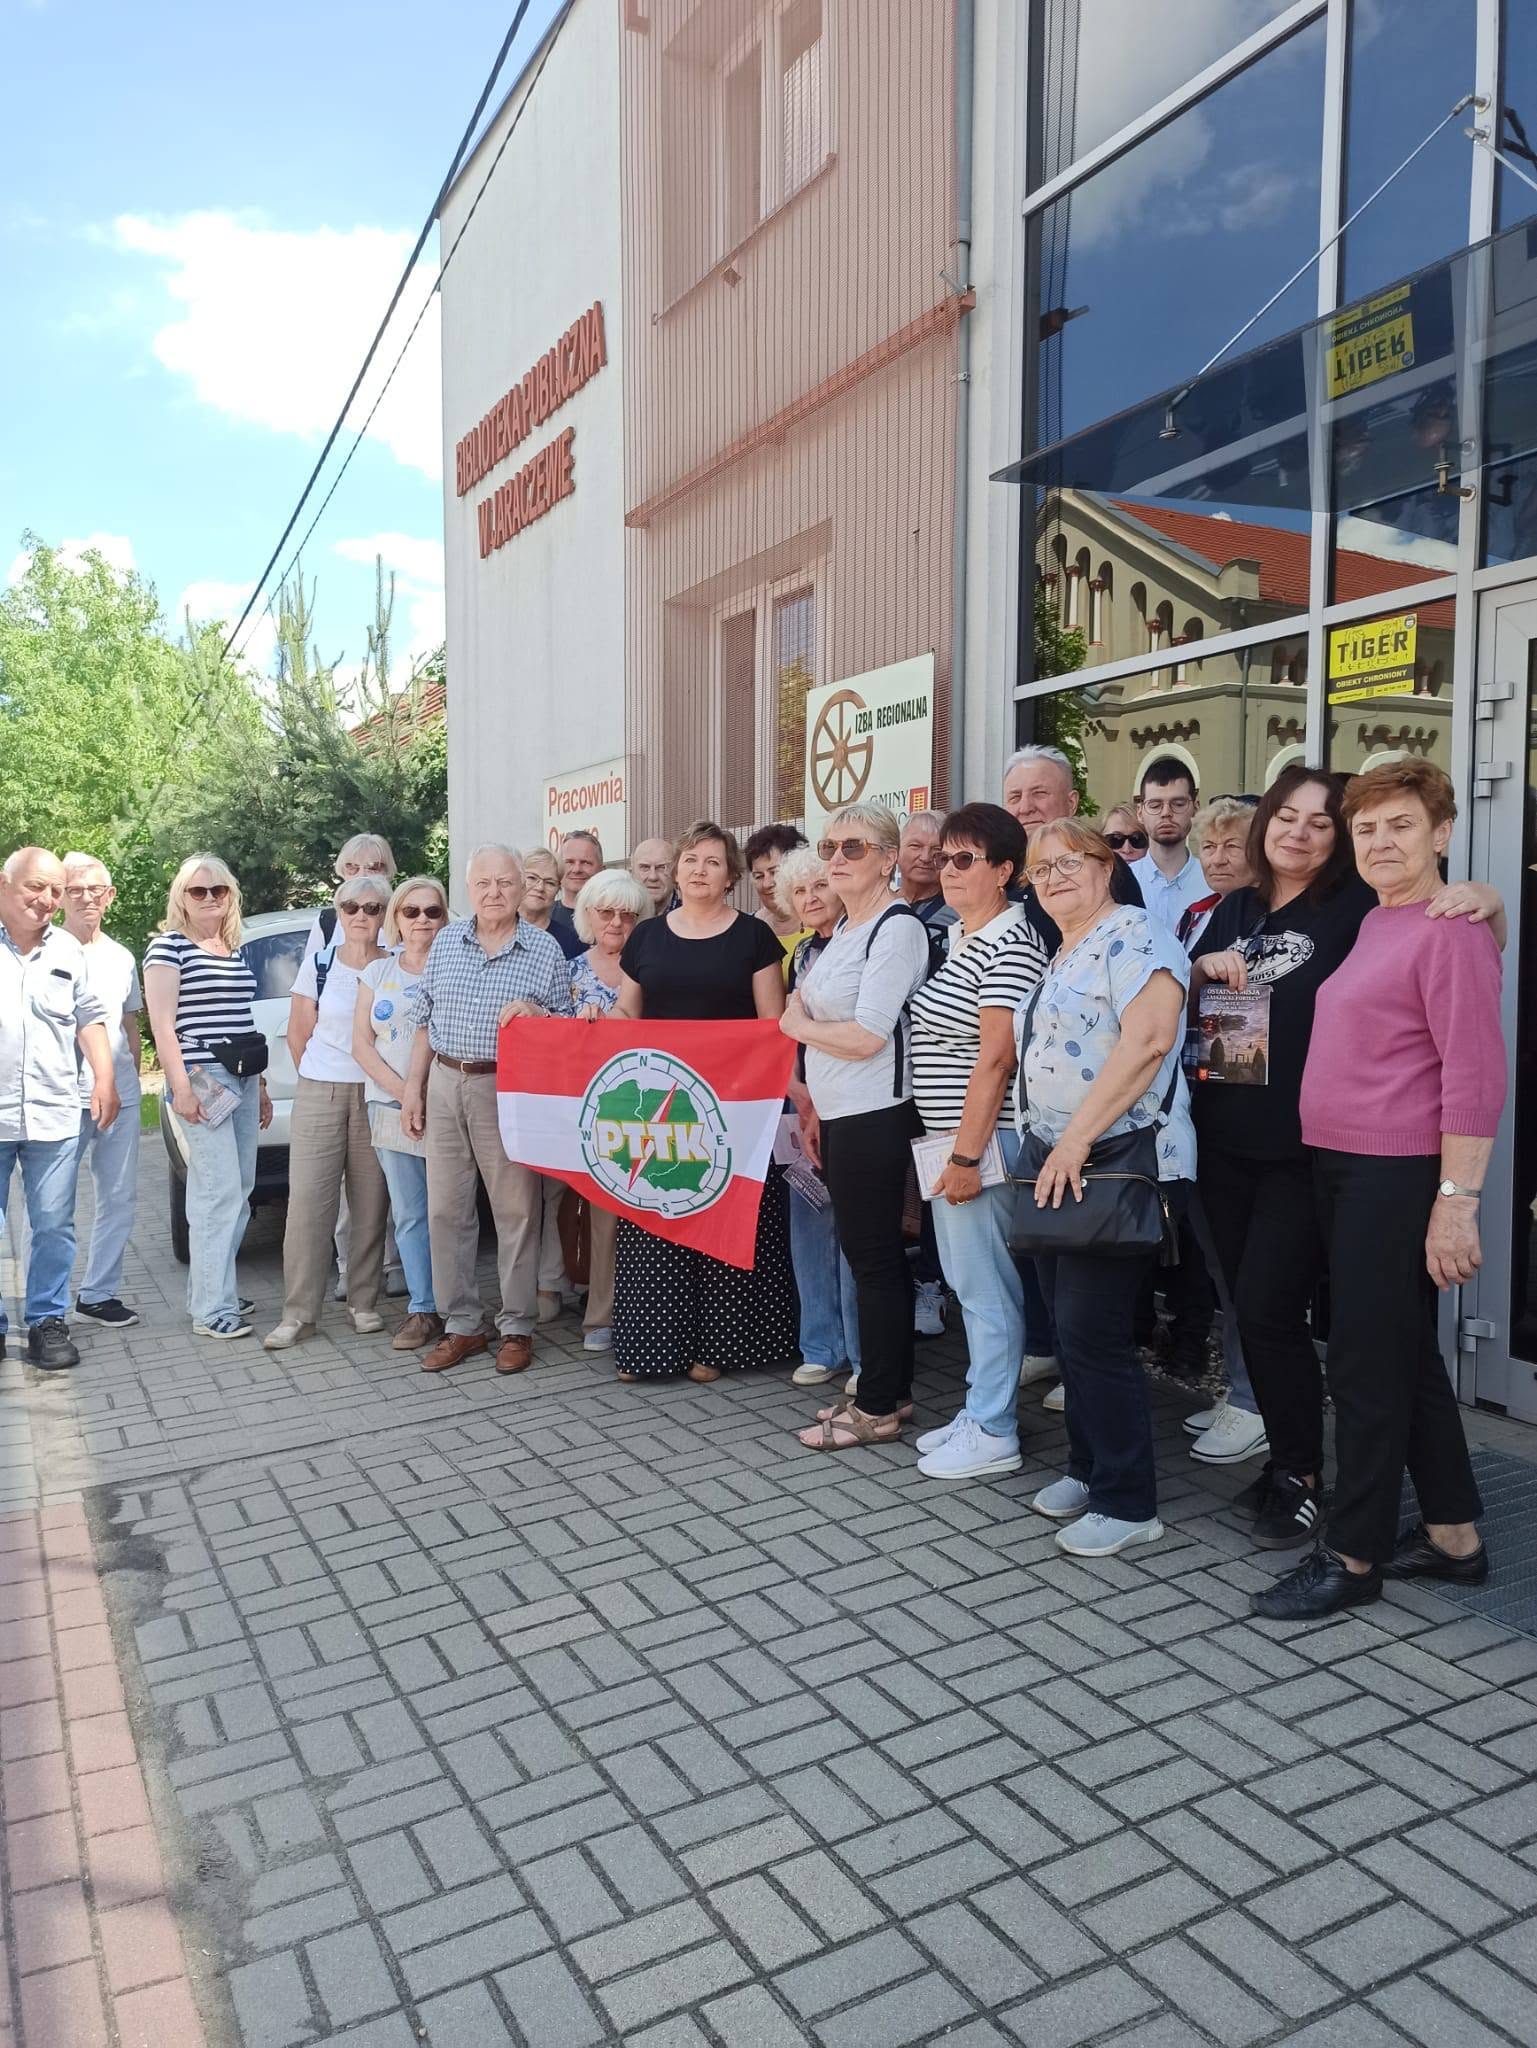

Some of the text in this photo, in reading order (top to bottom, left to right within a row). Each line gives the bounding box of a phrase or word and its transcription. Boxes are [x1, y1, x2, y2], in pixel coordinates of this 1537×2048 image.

[456, 300, 607, 497] BIBLIOTEKA PUBLICZNA
[490, 426, 576, 550] JARACZEWIE
[1337, 631, 1409, 664] TIGER
[1336, 677, 1363, 689] OBIEKT
[1363, 669, 1408, 684] CHRONIONY
[855, 695, 928, 734] IZBA REGIONALNA
[548, 770, 623, 817] Pracownia
[639, 1055, 648, 1067] N
[581, 1130, 592, 1142] W
[596, 1120, 712, 1161] PTTK
[716, 1134, 725, 1146] E
[662, 1202, 670, 1213] S
